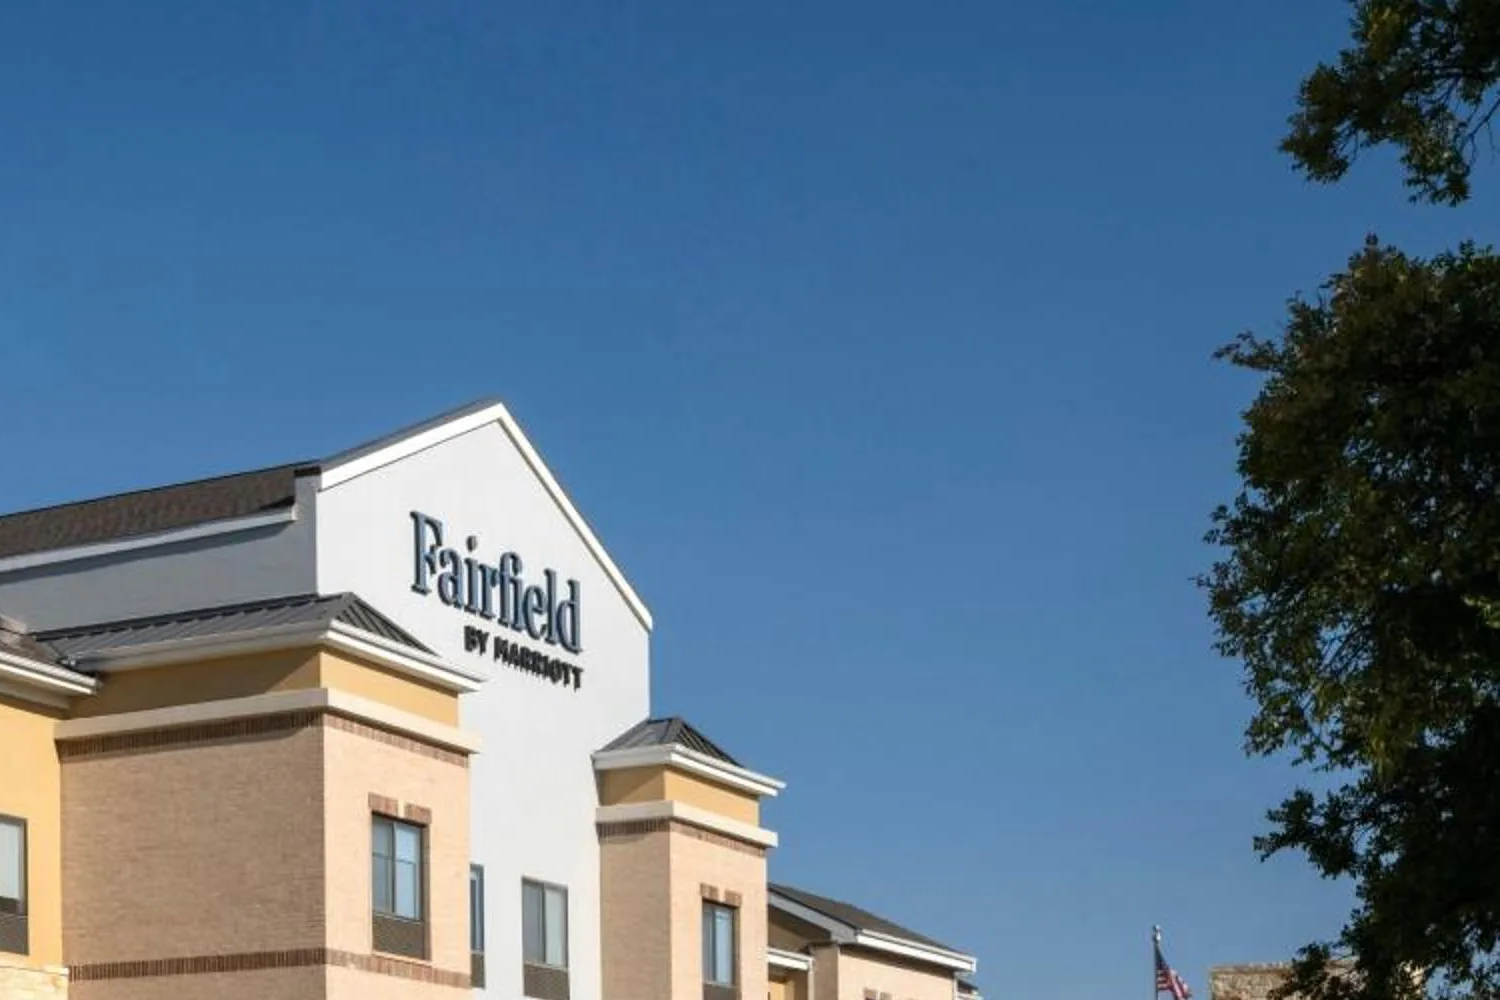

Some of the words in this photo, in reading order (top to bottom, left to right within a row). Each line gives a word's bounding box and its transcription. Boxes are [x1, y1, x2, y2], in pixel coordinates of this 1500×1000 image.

[409, 510, 582, 655] Fairfield
[463, 625, 489, 656] BY
[494, 636, 583, 691] MARRIOTT
